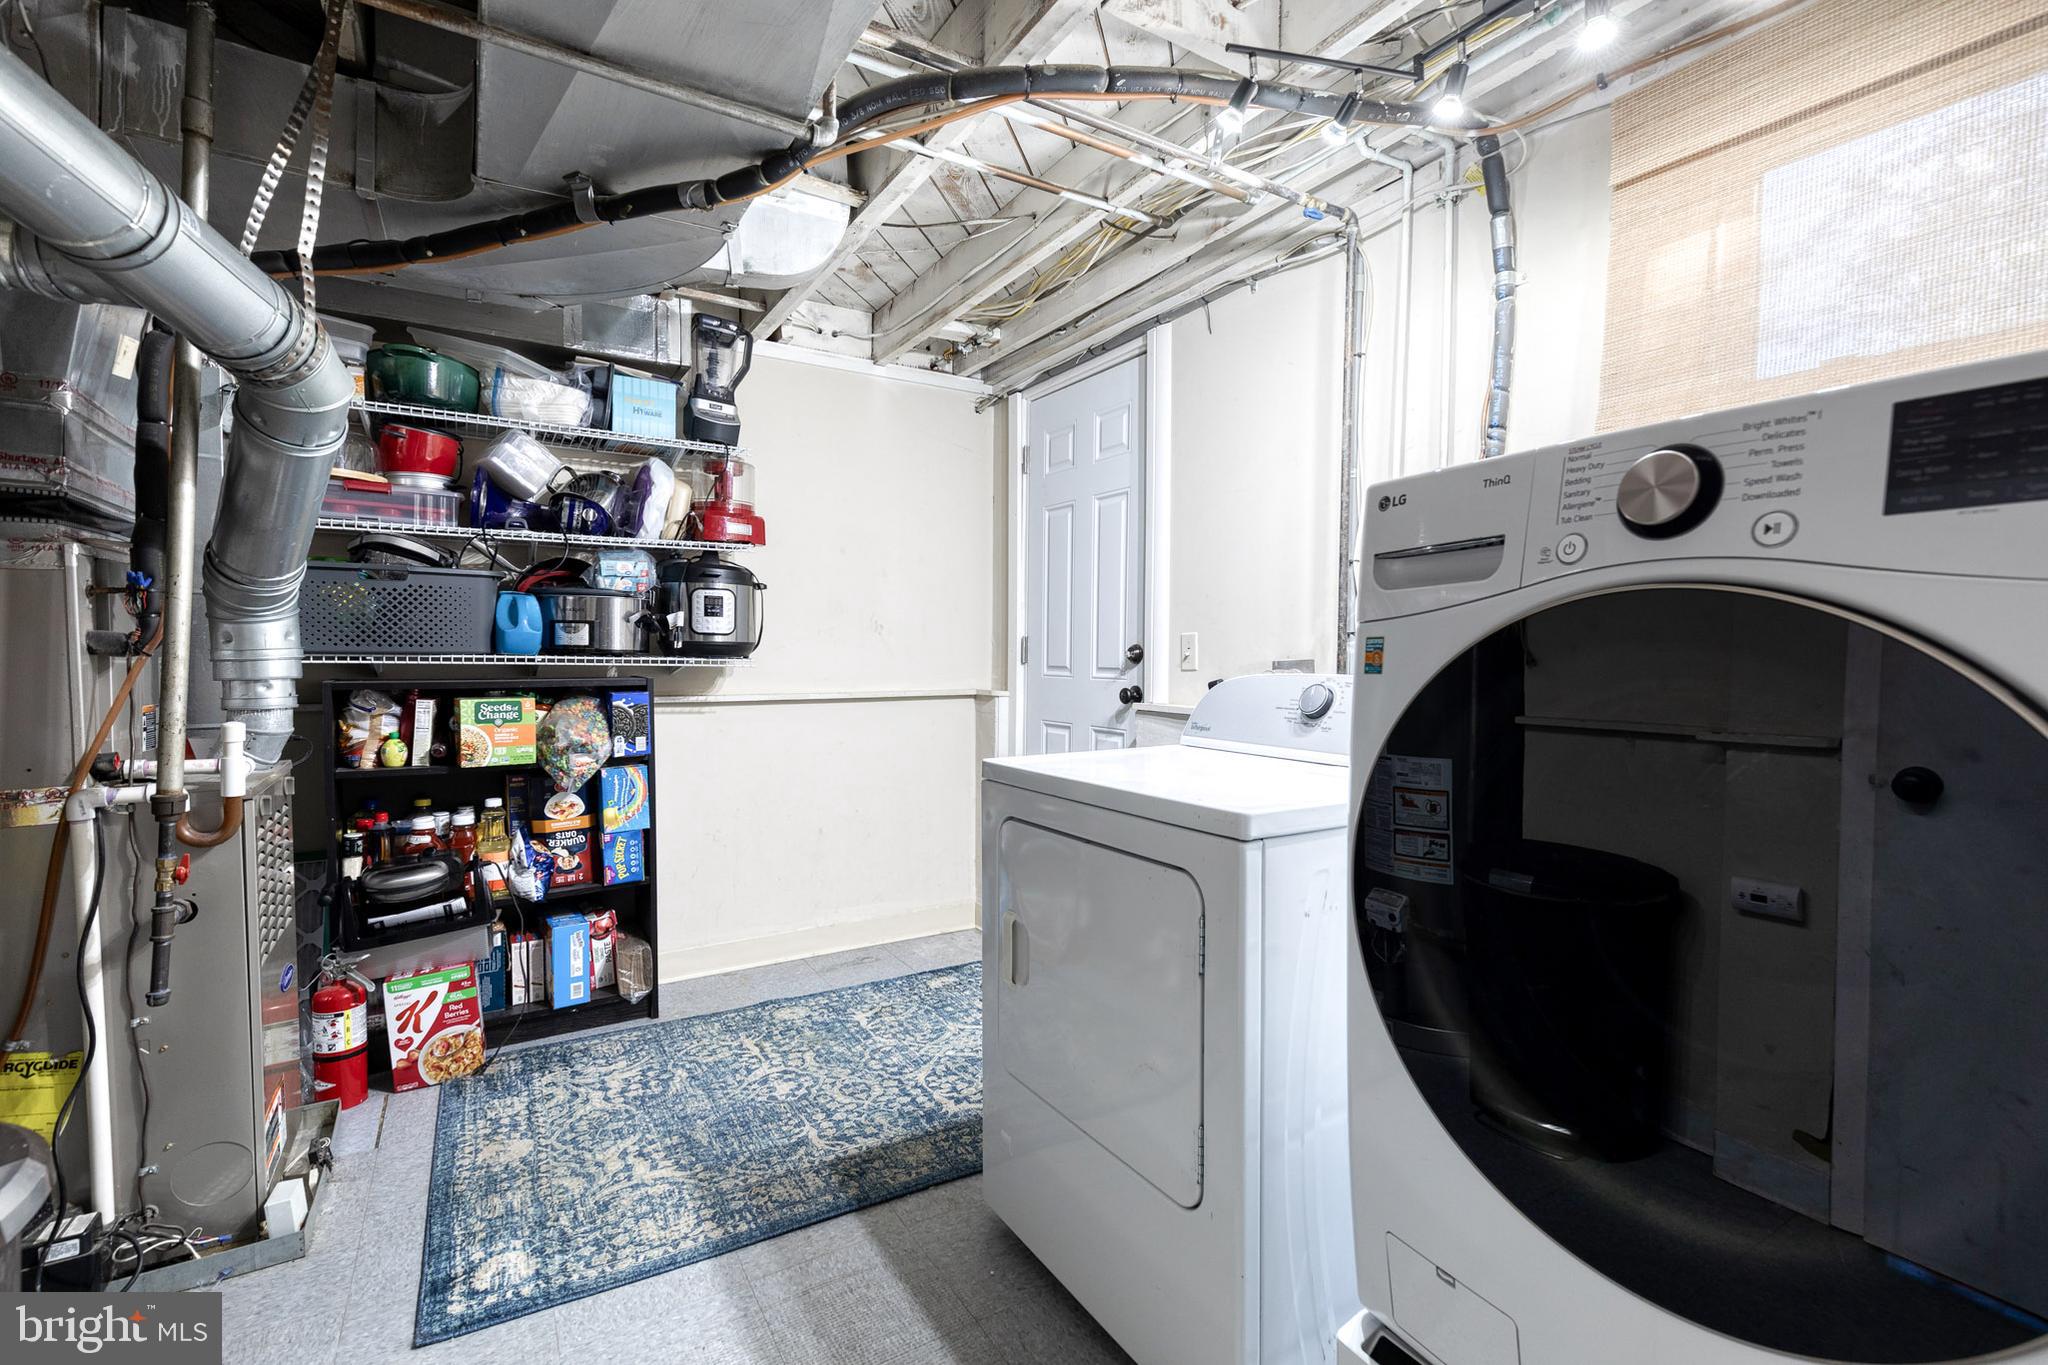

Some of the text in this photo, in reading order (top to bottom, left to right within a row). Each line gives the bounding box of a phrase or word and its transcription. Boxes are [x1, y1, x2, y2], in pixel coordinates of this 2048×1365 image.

[851, 109, 865, 121] 3/8
[886, 92, 907, 105] WALL
[1742, 420, 1771, 432] Bright
[1761, 429, 1806, 441] Delicates
[1778, 443, 1805, 452] Press
[1567, 452, 1592, 463] Normal
[1566, 462, 1605, 475] Heavy Duty
[1482, 474, 1511, 488] ThinQ
[1564, 477, 1592, 487] Bedding
[1743, 472, 1803, 487] Speed Wash
[1563, 490, 1591, 499] Sanitary
[1741, 487, 1801, 502] Downloaded
[1392, 494, 1407, 507] LG
[1573, 513, 1593, 523] Clean
[480, 703, 512, 712] Seeds
[477, 710, 520, 720] Change
[555, 830, 577, 839] OATS
[614, 835, 630, 880] POP SECRET
[395, 990, 439, 1034] K
[449, 1002, 463, 1012] Red
[444, 1009, 469, 1019] Berries
